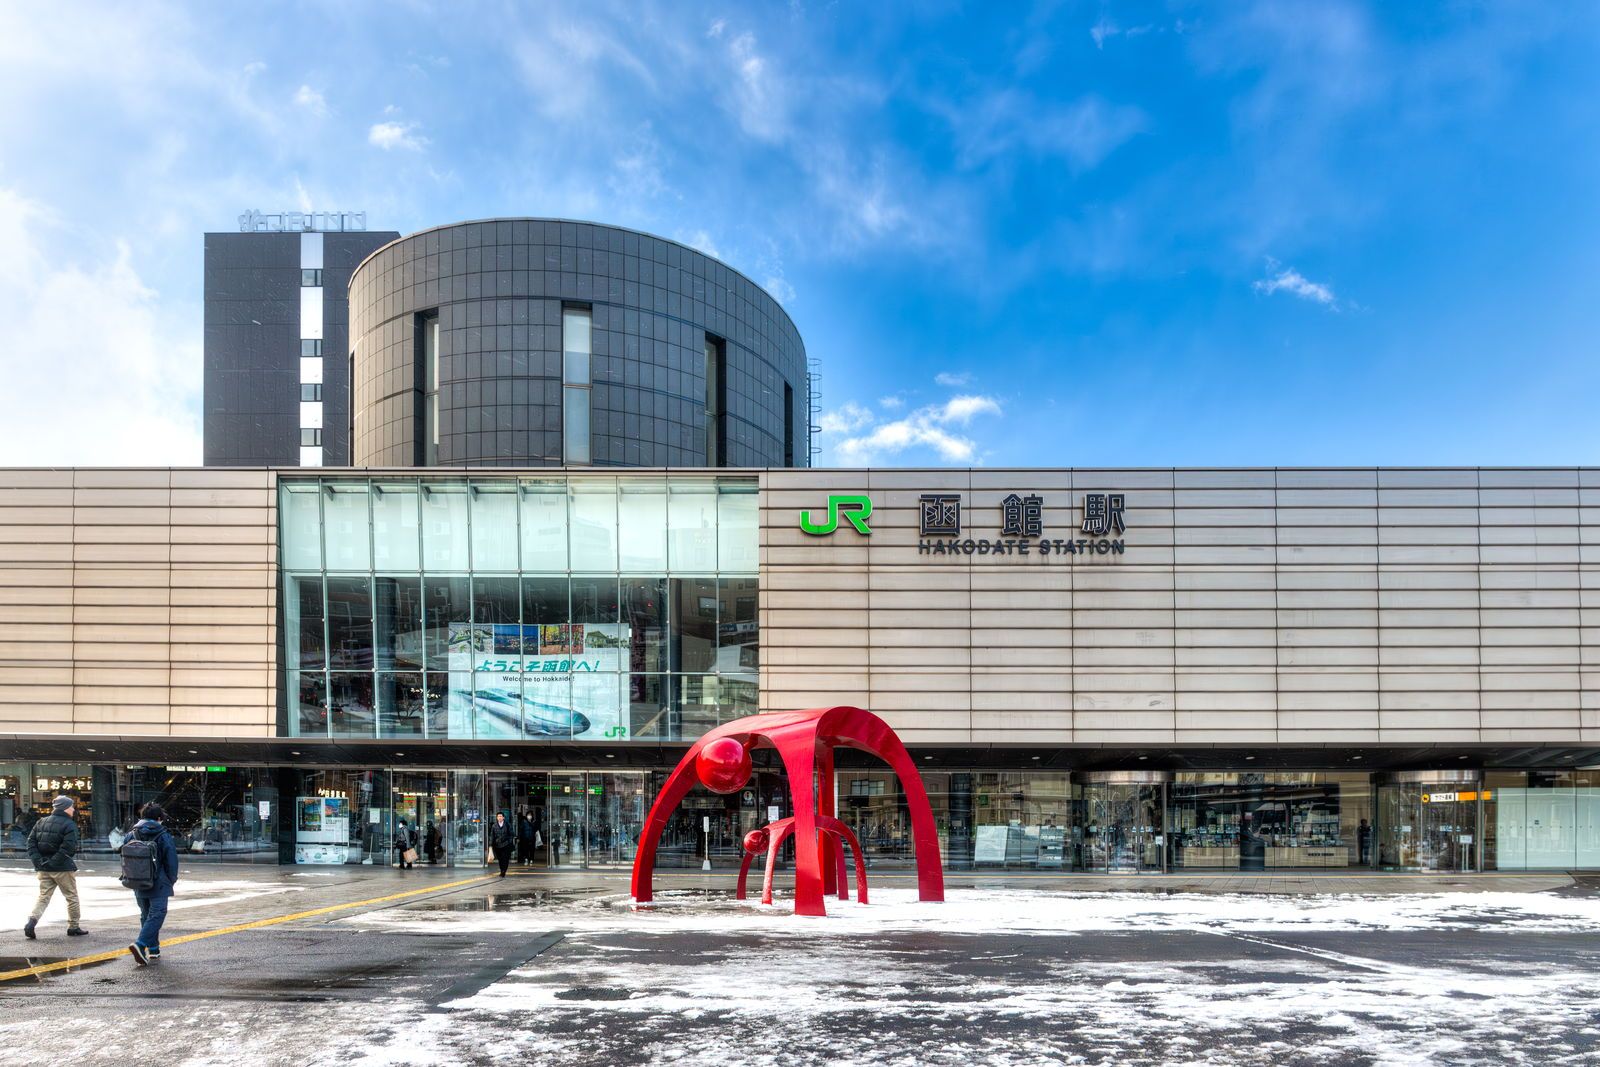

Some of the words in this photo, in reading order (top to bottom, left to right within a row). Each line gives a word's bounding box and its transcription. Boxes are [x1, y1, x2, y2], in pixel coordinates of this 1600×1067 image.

[799, 495, 873, 535] JR
[919, 492, 1127, 536] 函館駅
[919, 539, 1030, 555] HAKODATE
[1038, 539, 1126, 555] STATION
[605, 726, 626, 738] JR
